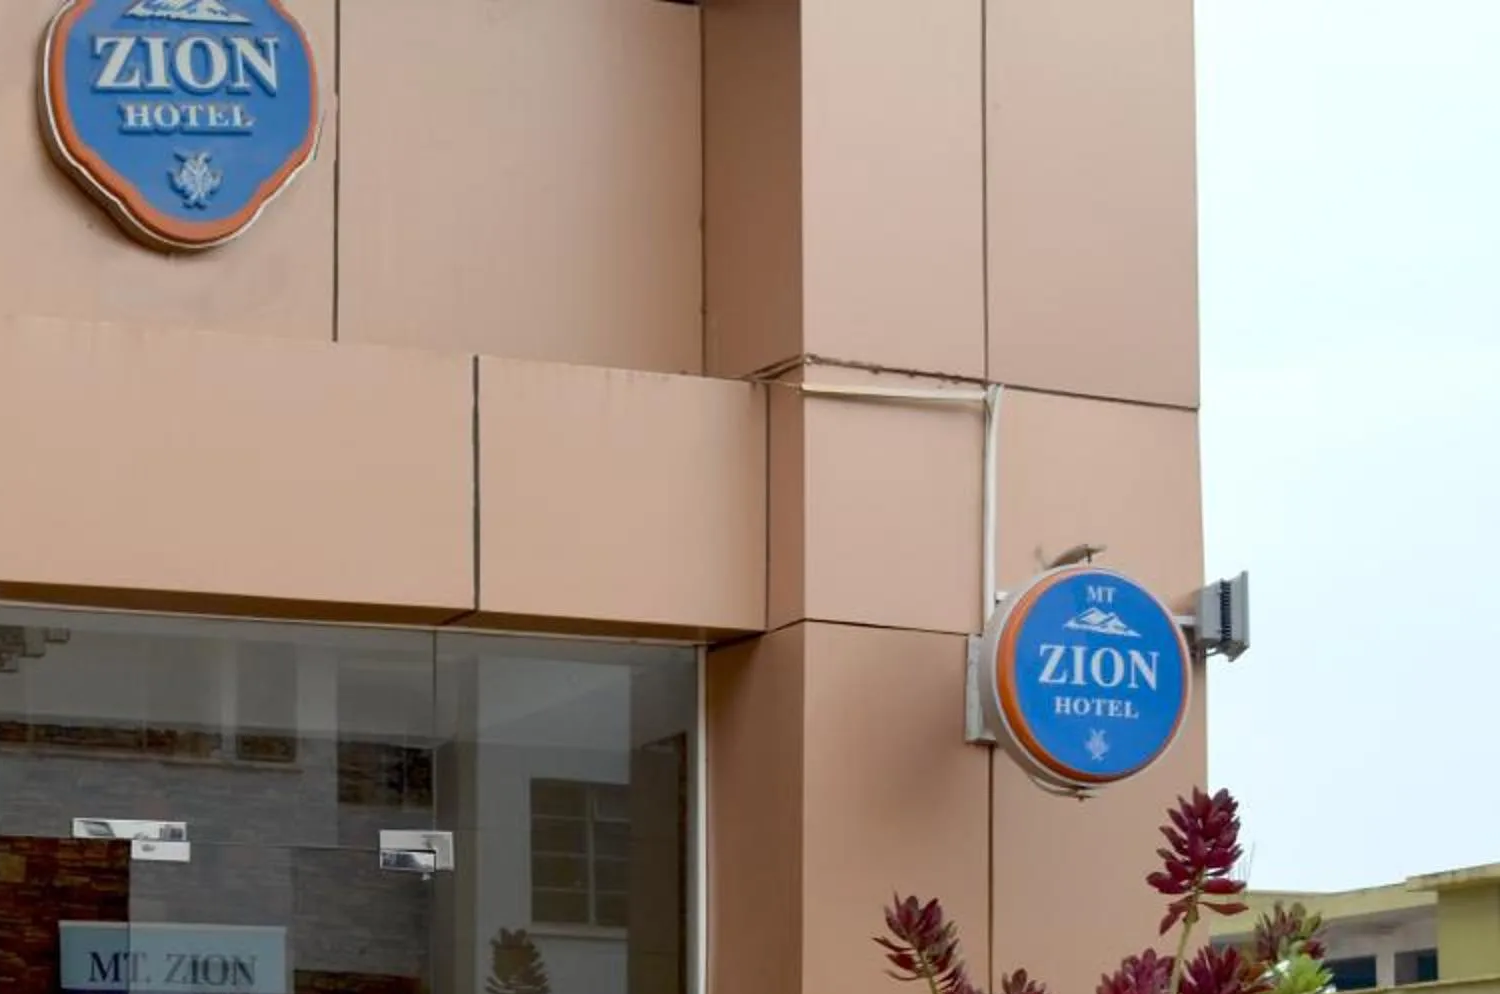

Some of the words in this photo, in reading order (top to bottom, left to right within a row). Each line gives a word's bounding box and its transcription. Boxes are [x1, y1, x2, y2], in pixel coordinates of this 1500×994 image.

[93, 36, 280, 95] ZION
[122, 103, 256, 131] HOTEL
[1086, 585, 1116, 605] MT
[1038, 644, 1160, 691] ZION
[1055, 696, 1139, 719] HOTEL
[164, 953, 258, 987] ZION
